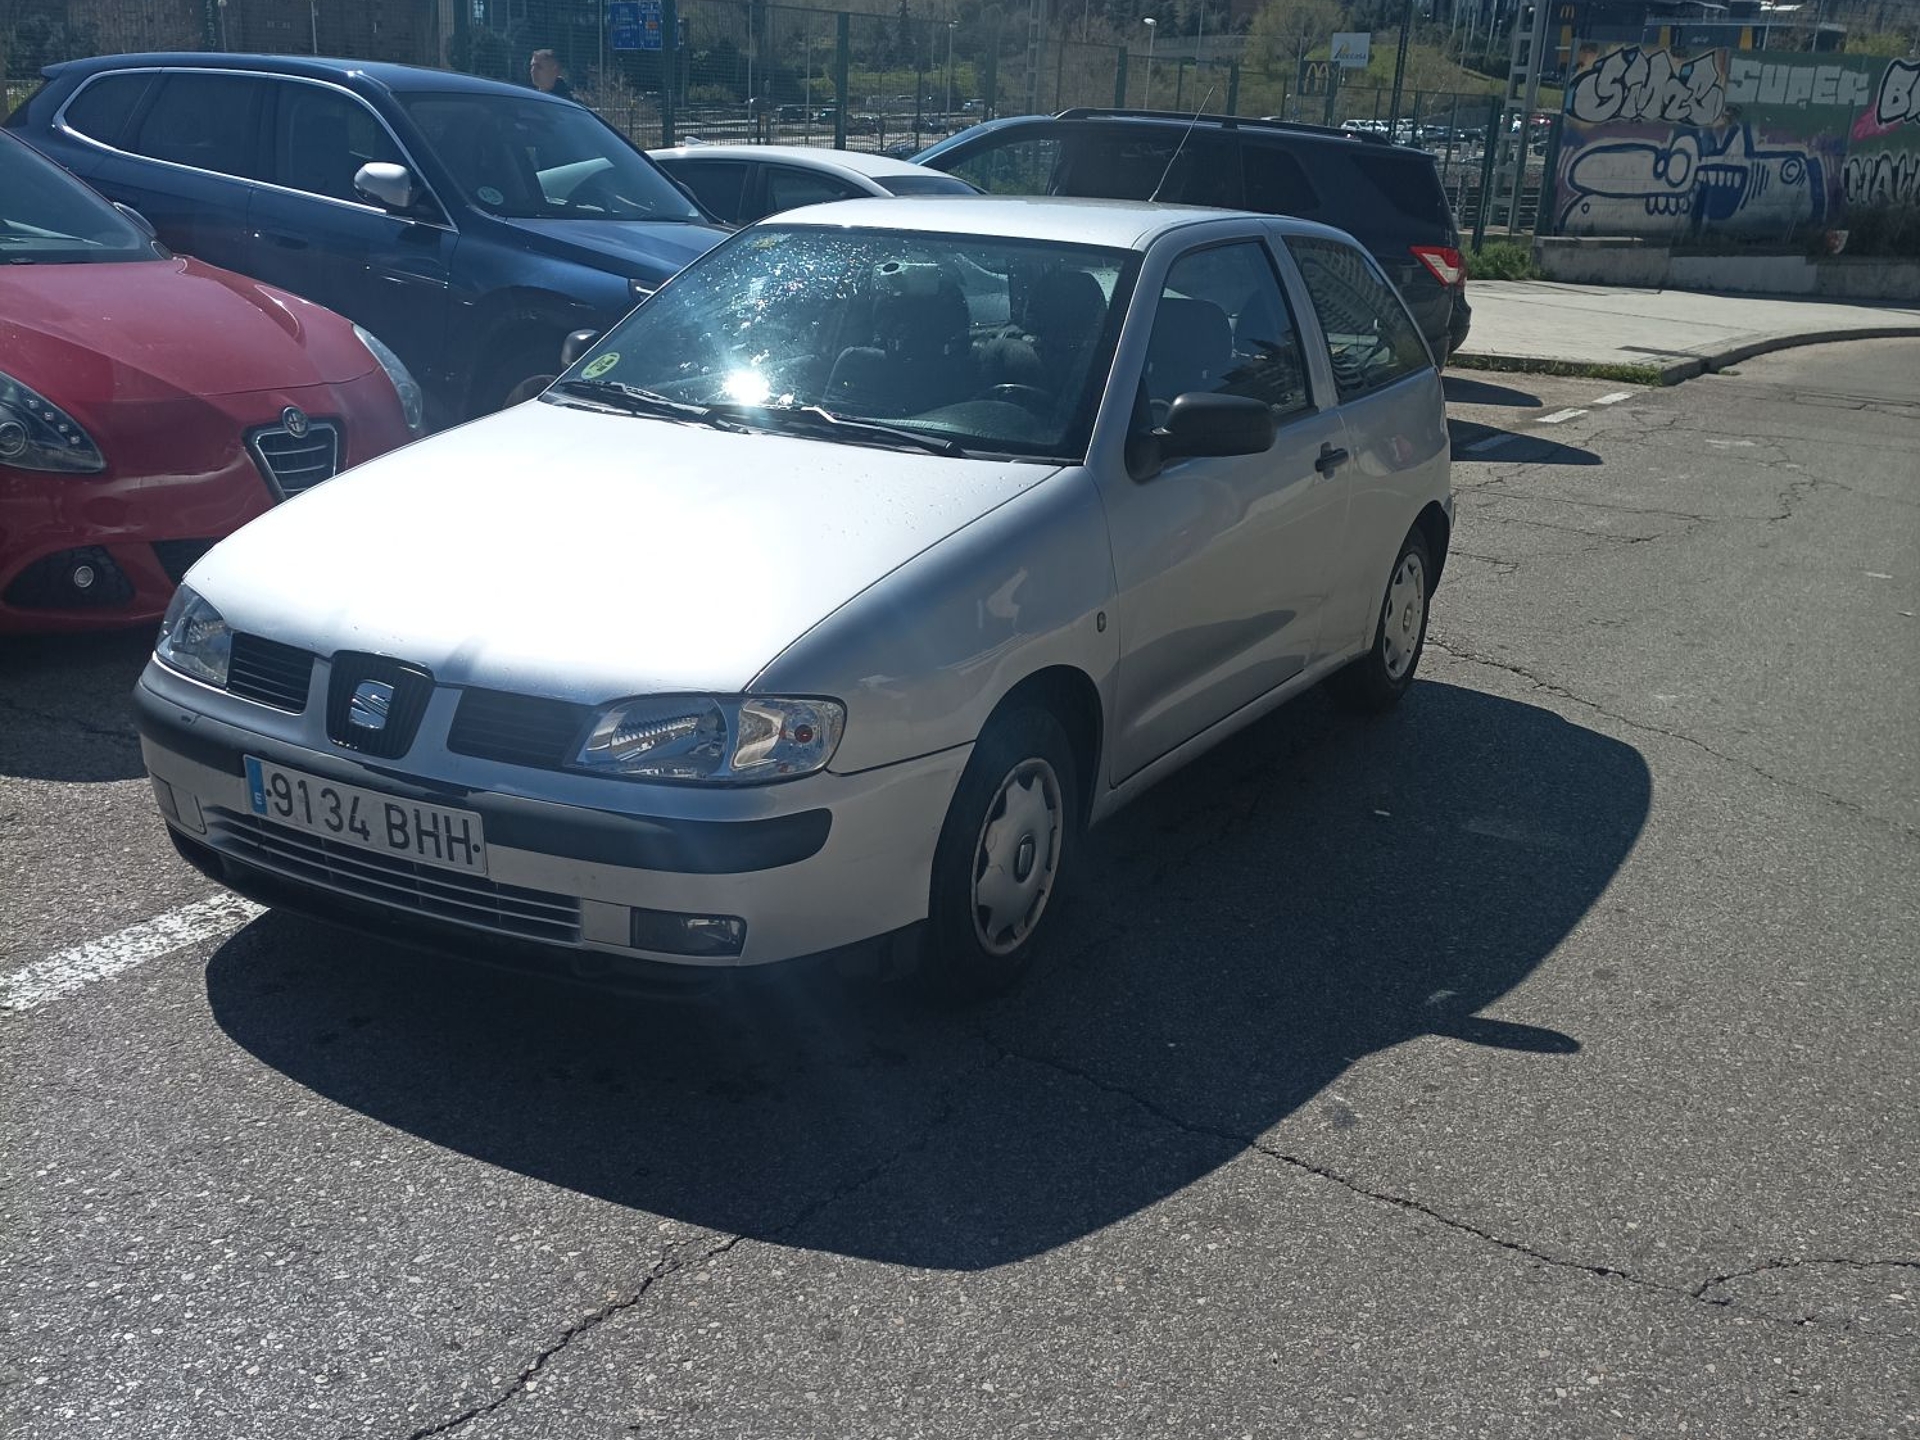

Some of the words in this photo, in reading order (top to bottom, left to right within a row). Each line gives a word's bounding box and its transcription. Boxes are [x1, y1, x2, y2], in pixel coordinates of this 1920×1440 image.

[1724, 57, 1870, 106] SUPER
[270, 772, 370, 842] 9134
[384, 802, 473, 866] BHH
